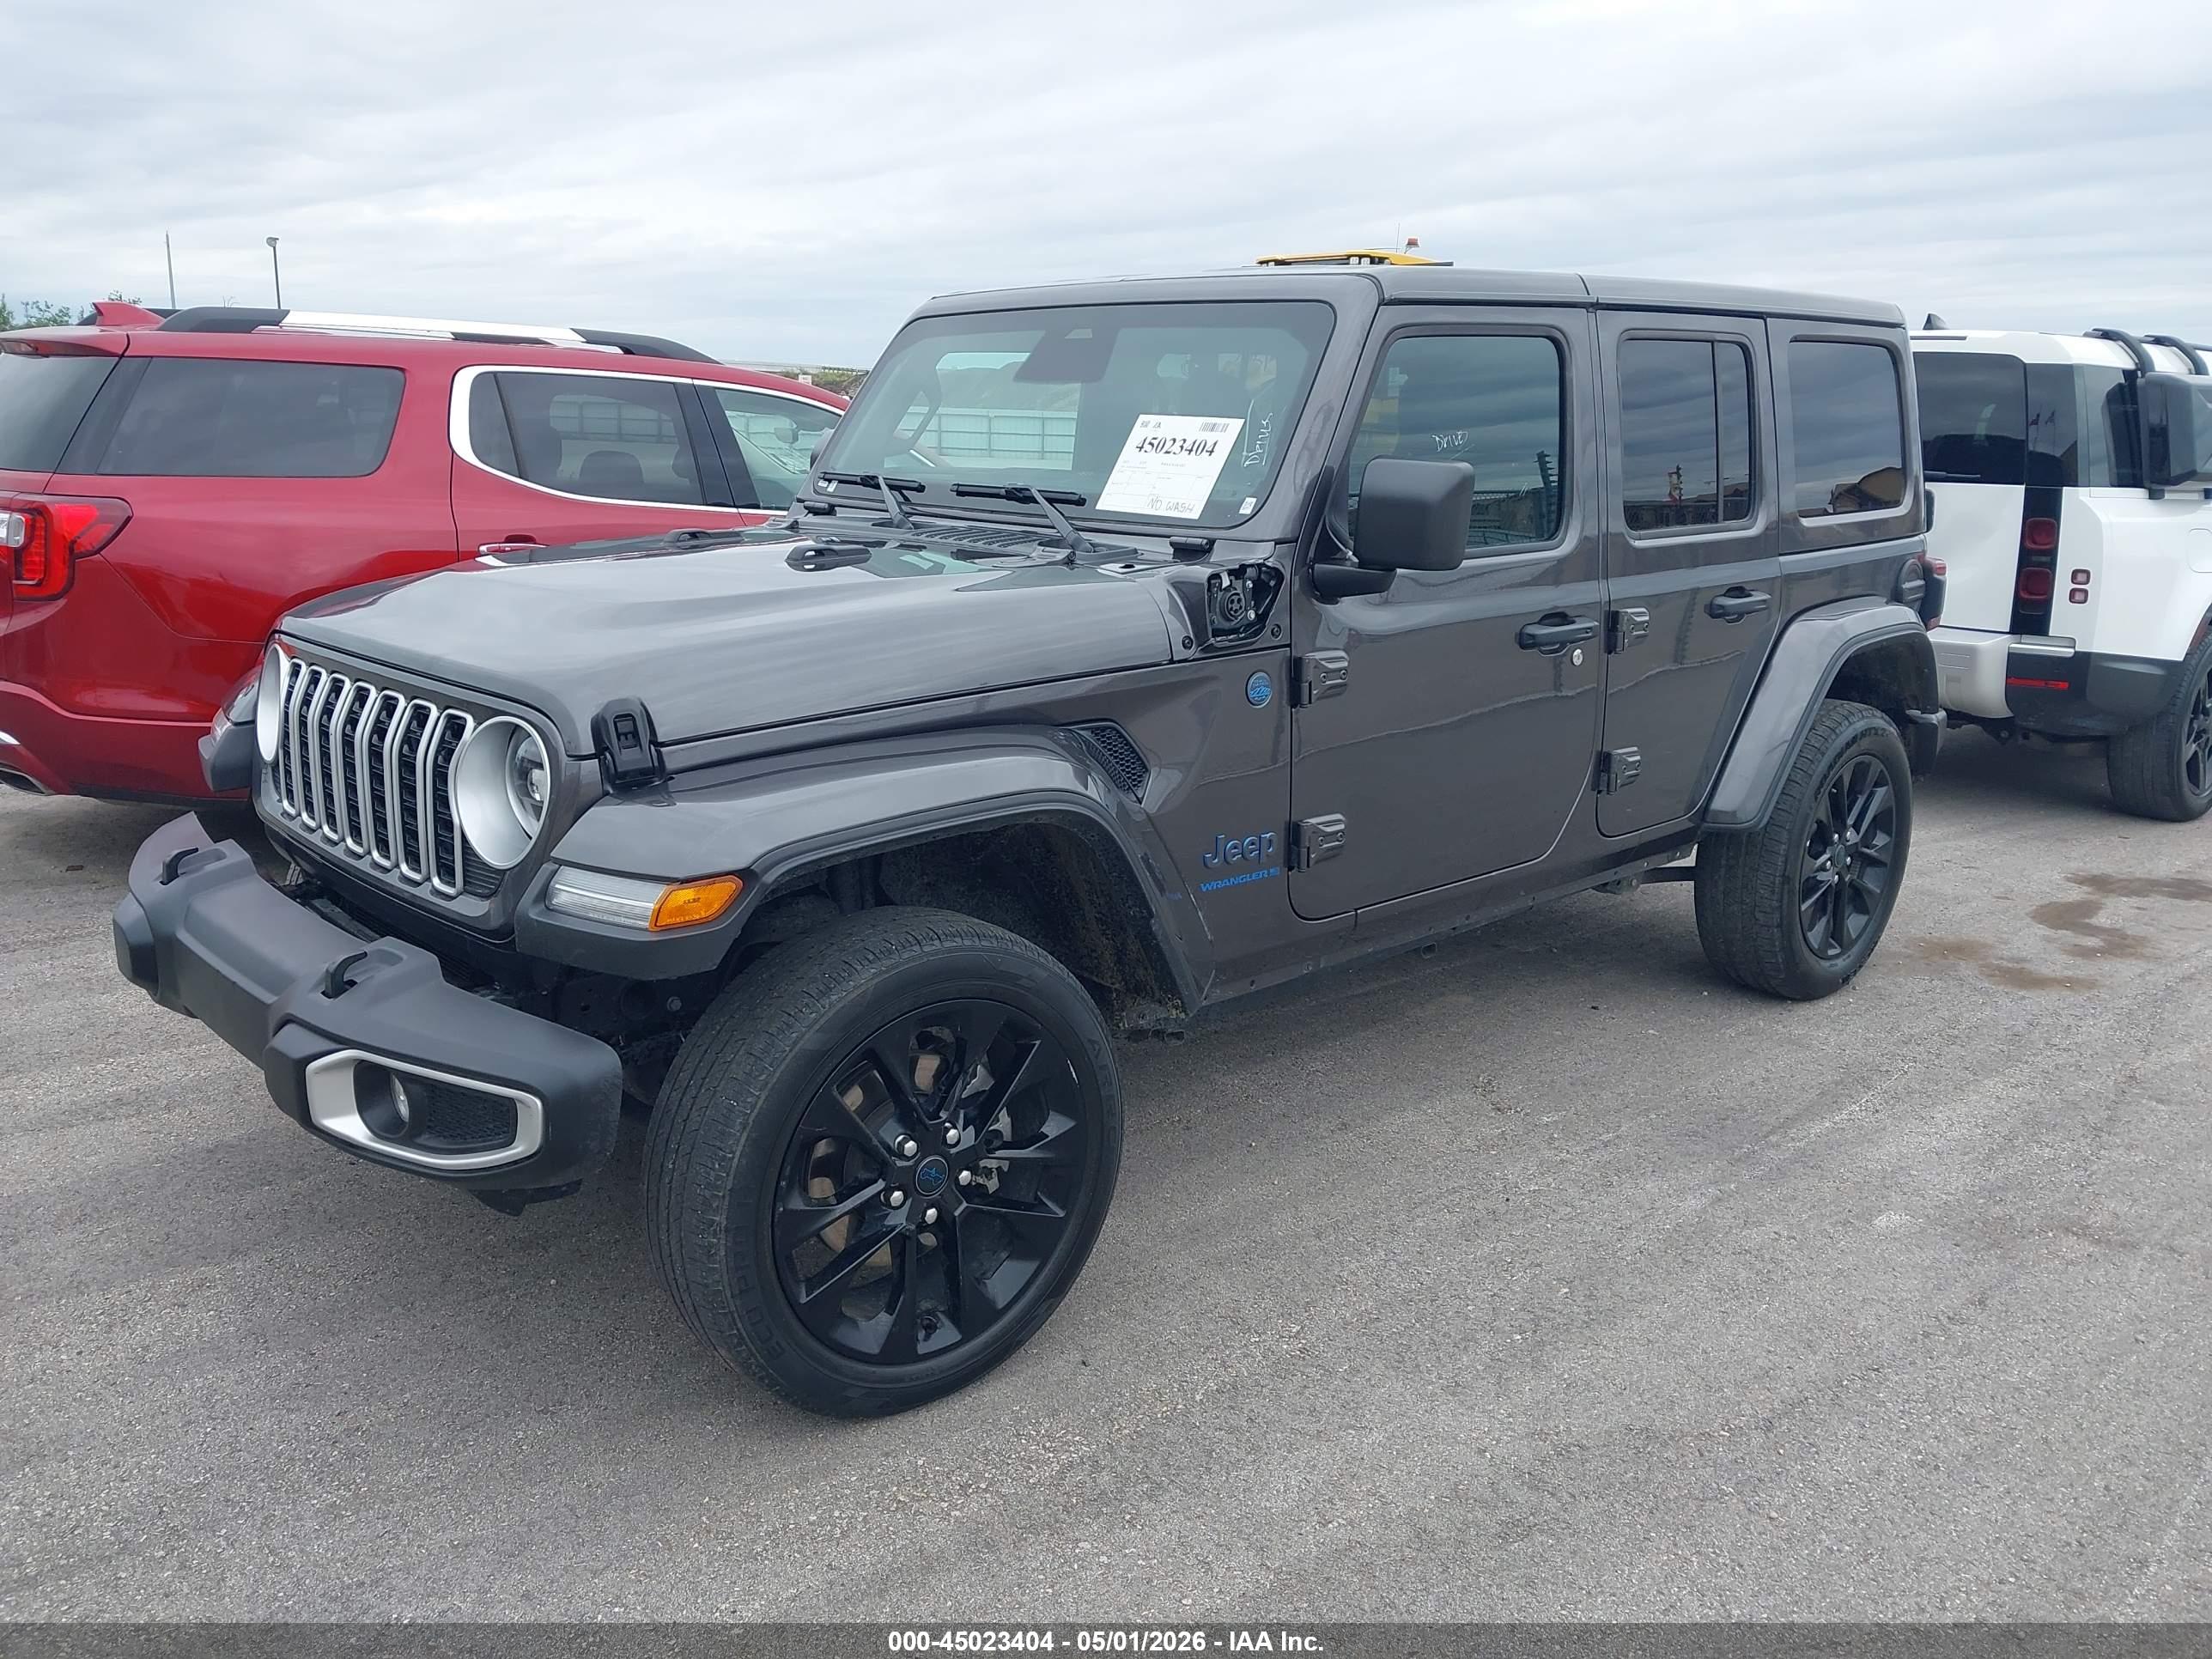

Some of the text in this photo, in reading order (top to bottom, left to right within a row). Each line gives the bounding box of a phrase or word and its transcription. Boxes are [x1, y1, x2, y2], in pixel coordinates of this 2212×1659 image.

[1135, 435, 1219, 457] 45023404
[1147, 495, 1195, 514] NO WASH
[1203, 831, 1278, 869] Jeep
[1199, 869, 1268, 892] WRANGLER
